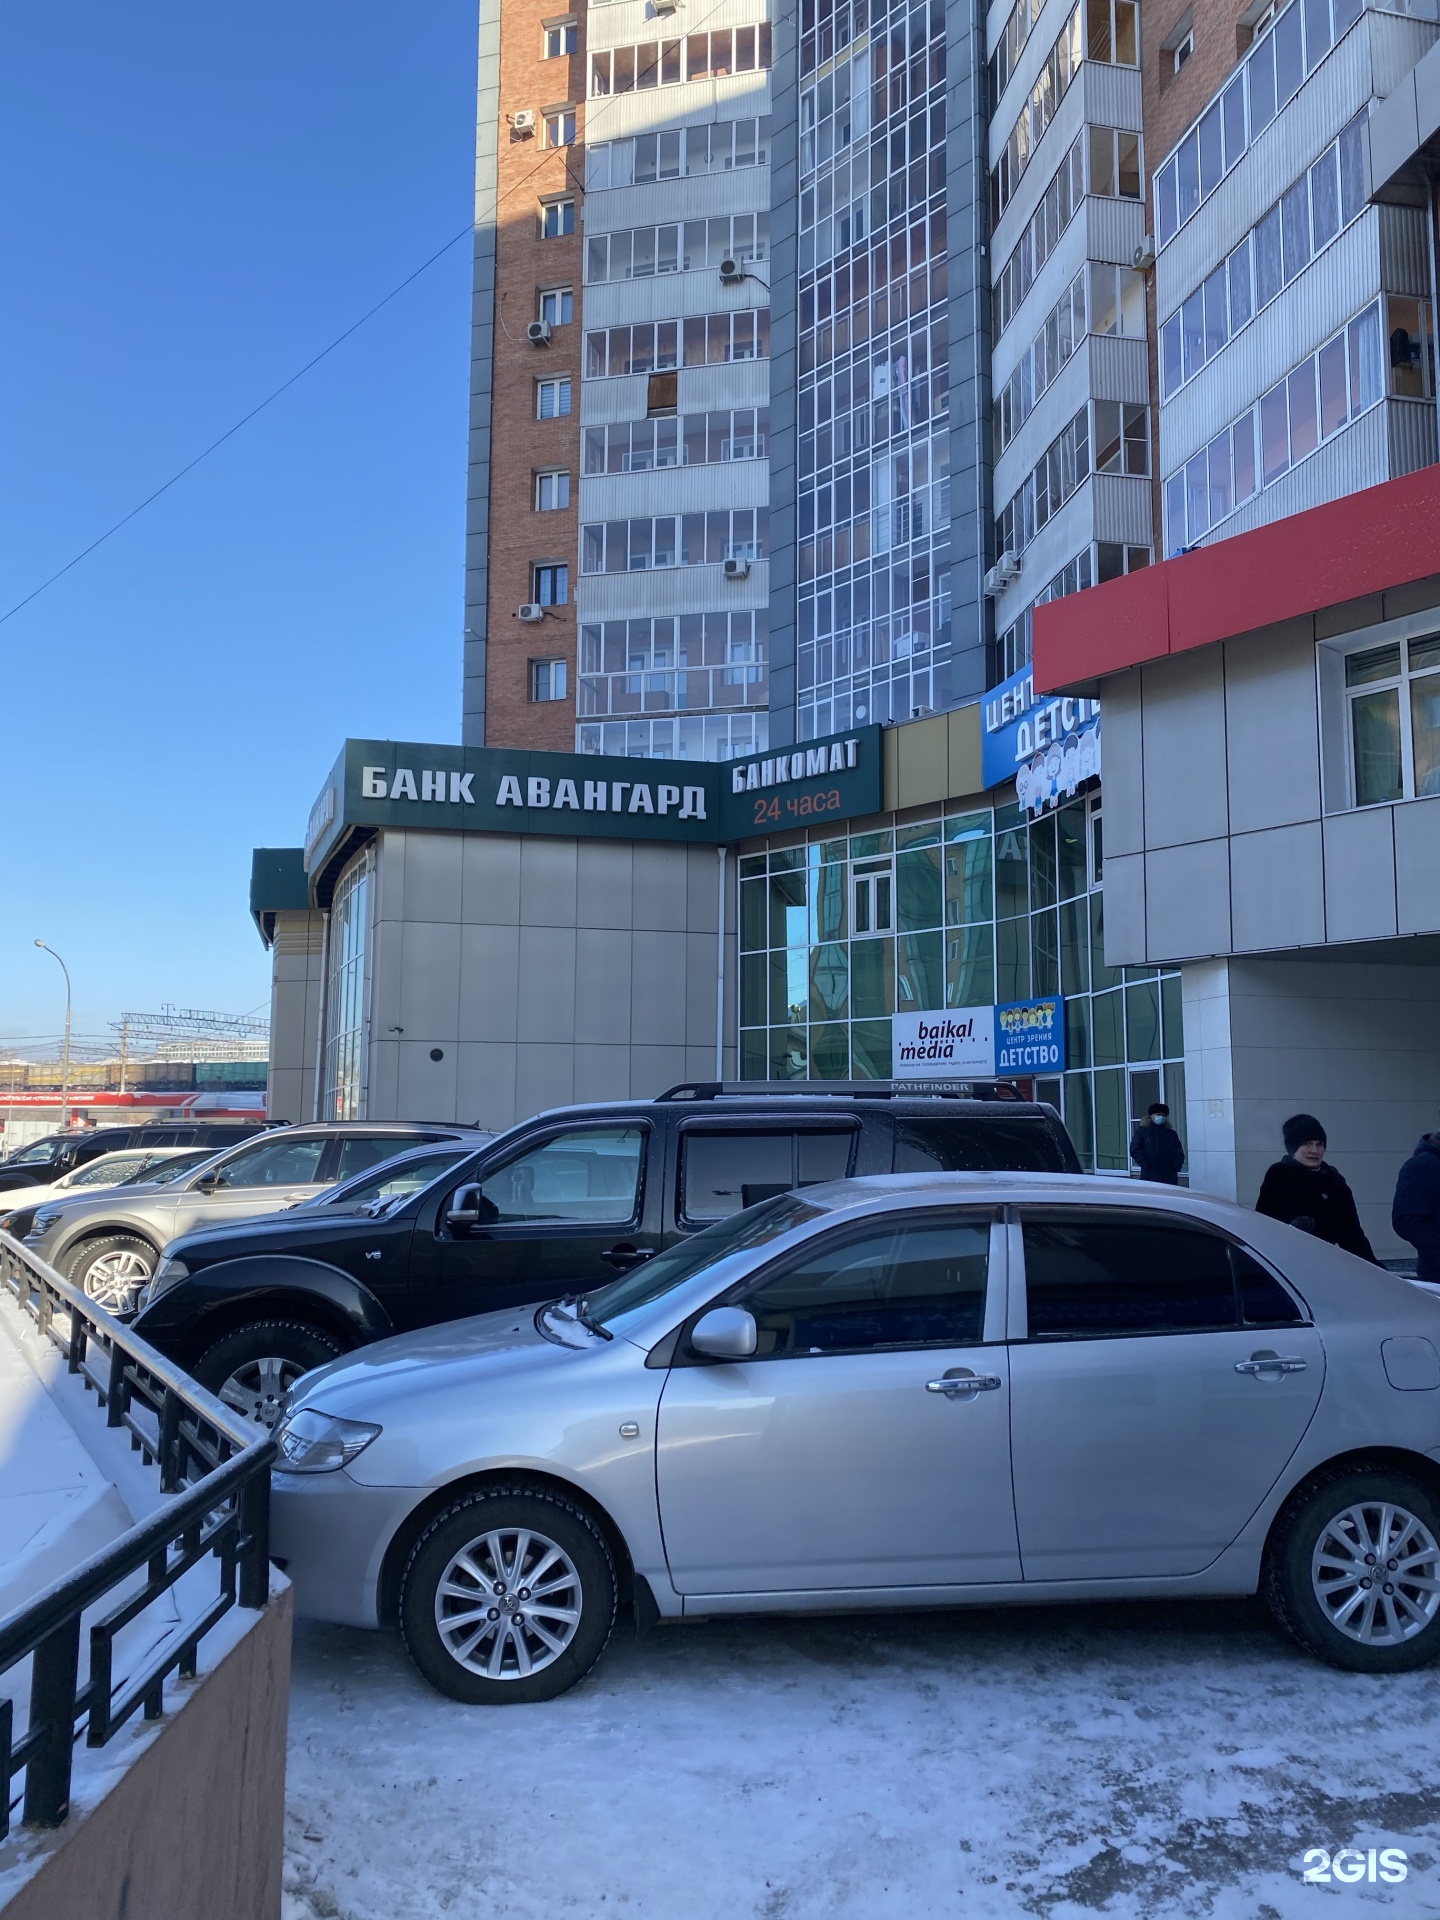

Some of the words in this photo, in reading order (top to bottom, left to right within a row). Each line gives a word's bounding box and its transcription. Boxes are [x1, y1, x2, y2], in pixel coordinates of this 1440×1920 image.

[732, 738, 860, 794] БАНКОМАТ
[362, 766, 475, 805] БАНК
[496, 774, 707, 820] АВАНГАРД
[753, 796, 781, 825] 24
[786, 789, 841, 817] часа
[918, 1018, 973, 1040] baikal
[1006, 1035, 1025, 1044] ЦЕНТР
[1027, 1032, 1052, 1043] ЗРЕНИЯ
[900, 1040, 954, 1060] media
[999, 1044, 1059, 1067] ДЕТСТВО
[890, 1083, 969, 1091] PATHFINDER
[365, 1250, 382, 1259] V6
